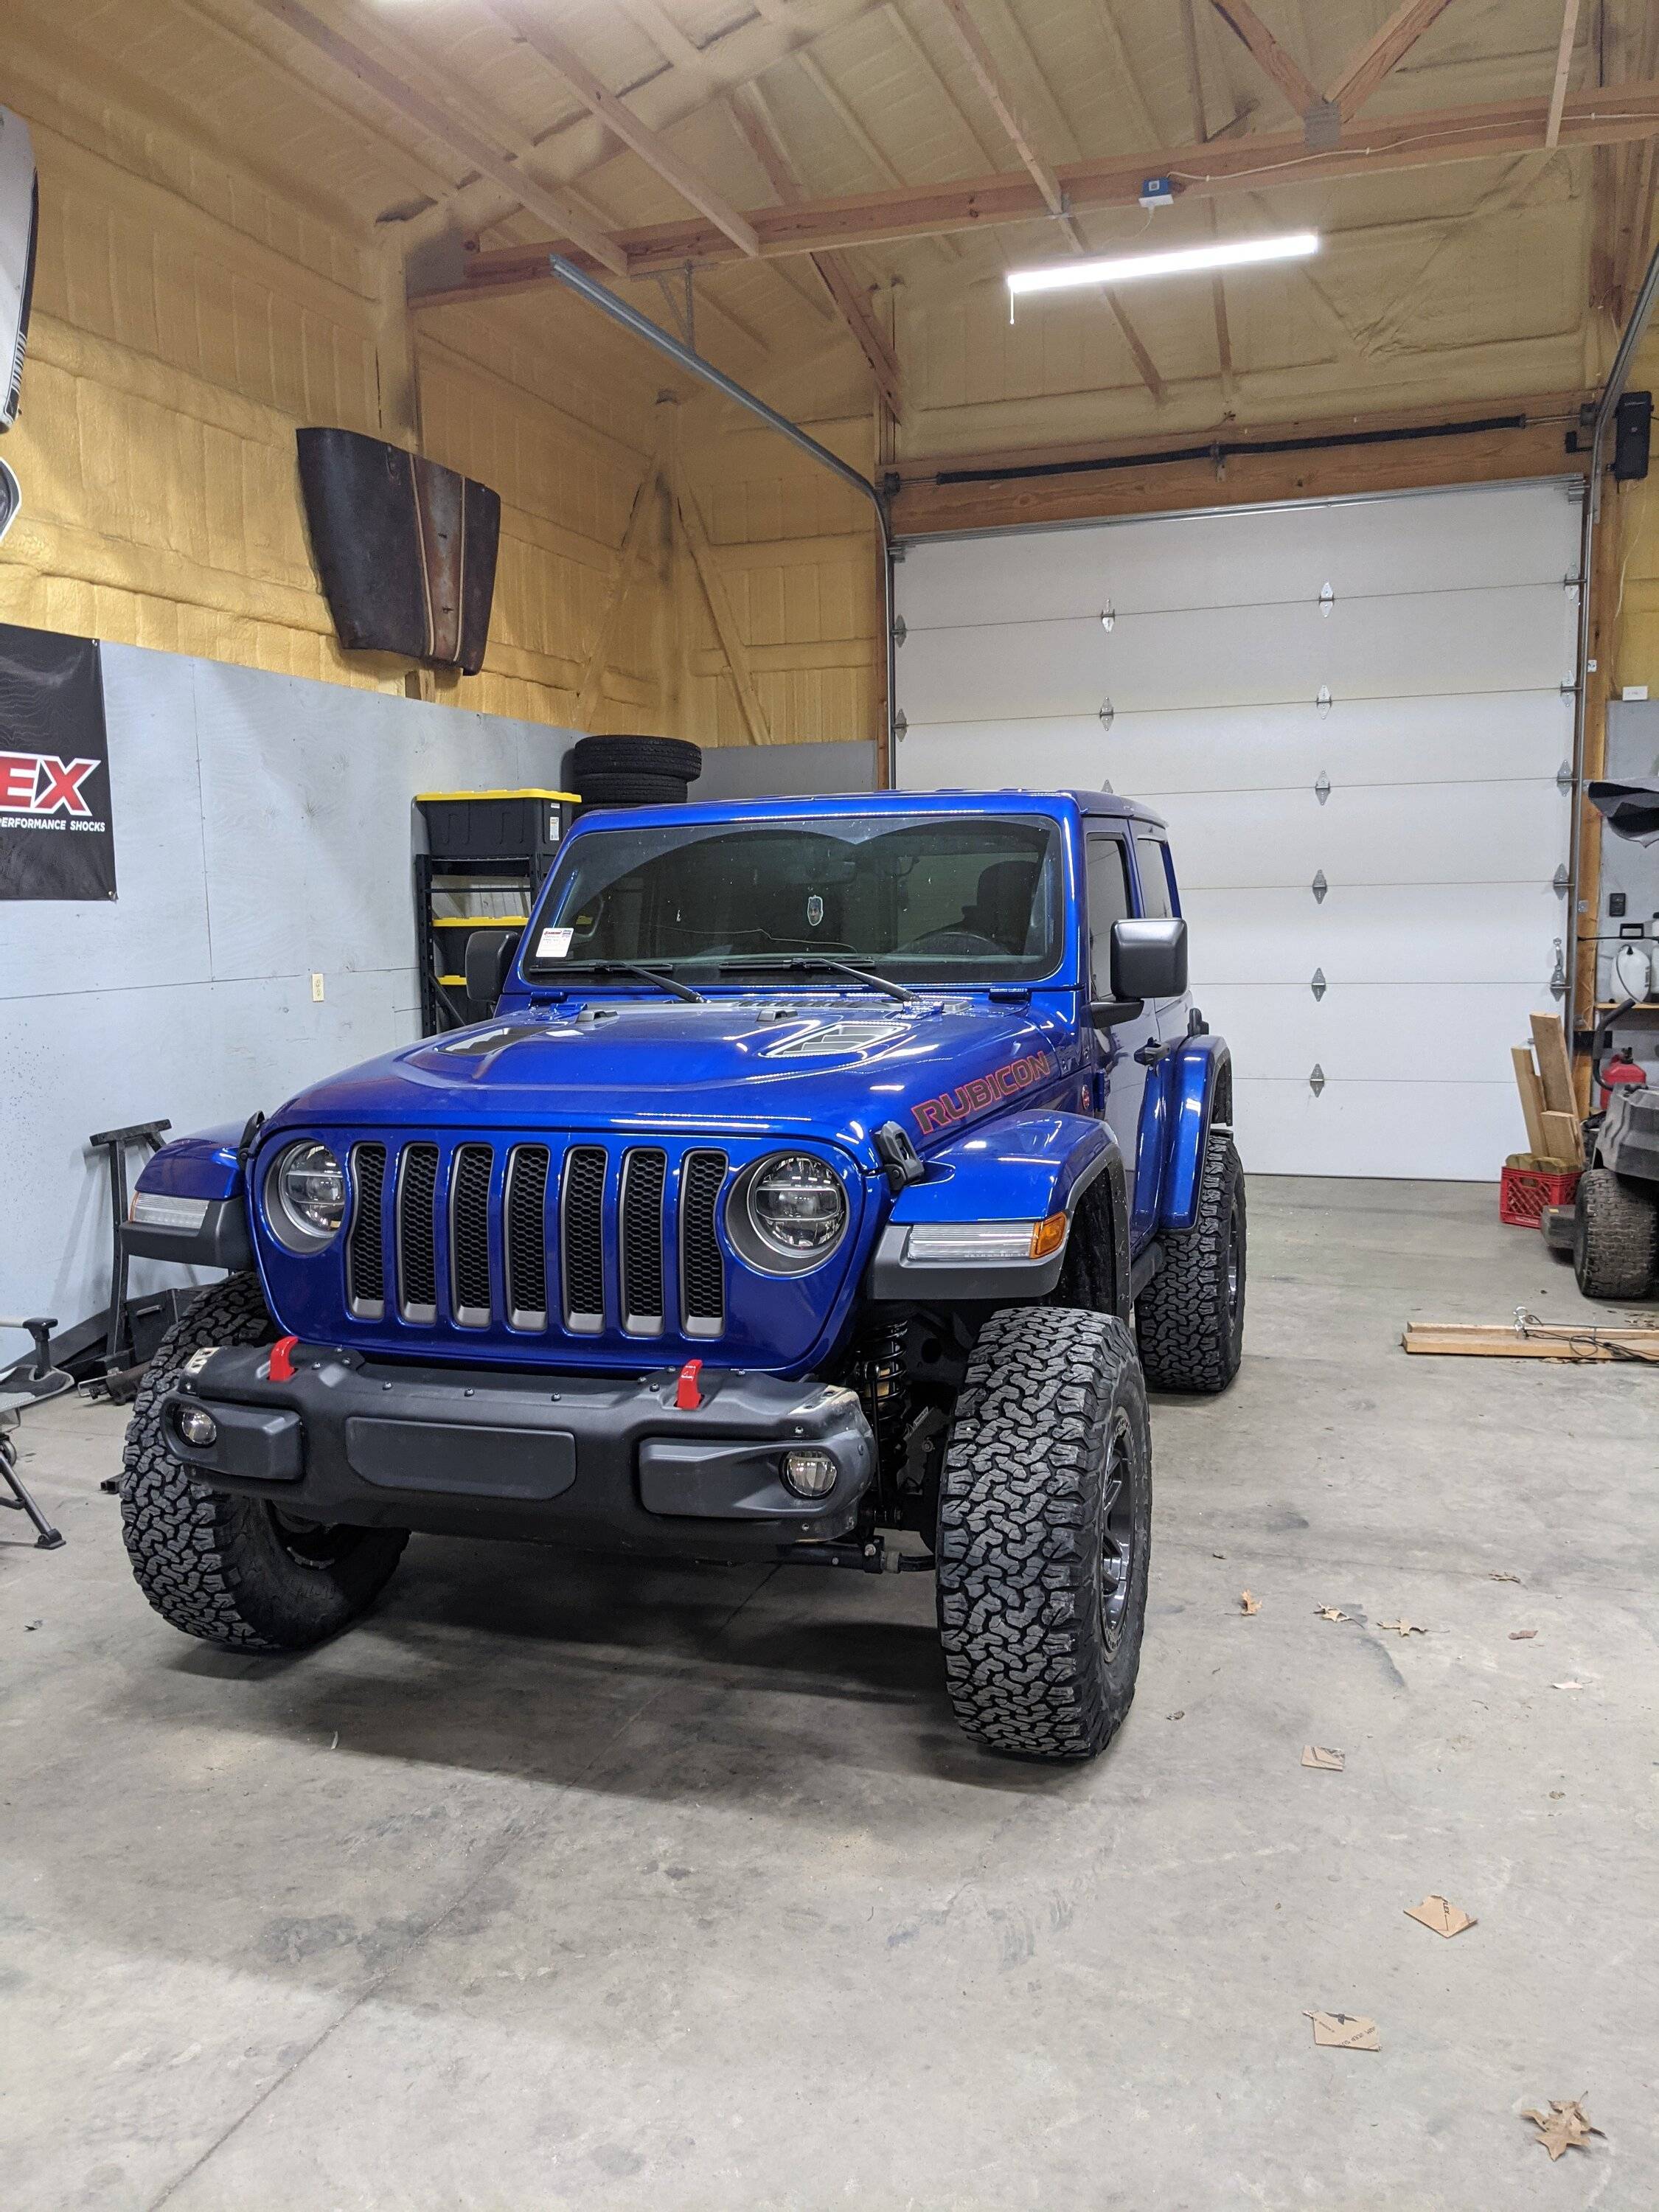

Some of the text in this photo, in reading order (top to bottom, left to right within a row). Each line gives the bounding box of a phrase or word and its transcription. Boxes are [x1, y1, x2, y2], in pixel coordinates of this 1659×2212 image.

[0, 817, 105, 832] ERFORMANCE SHOCKS
[911, 1050, 1051, 1135] RUBICON
